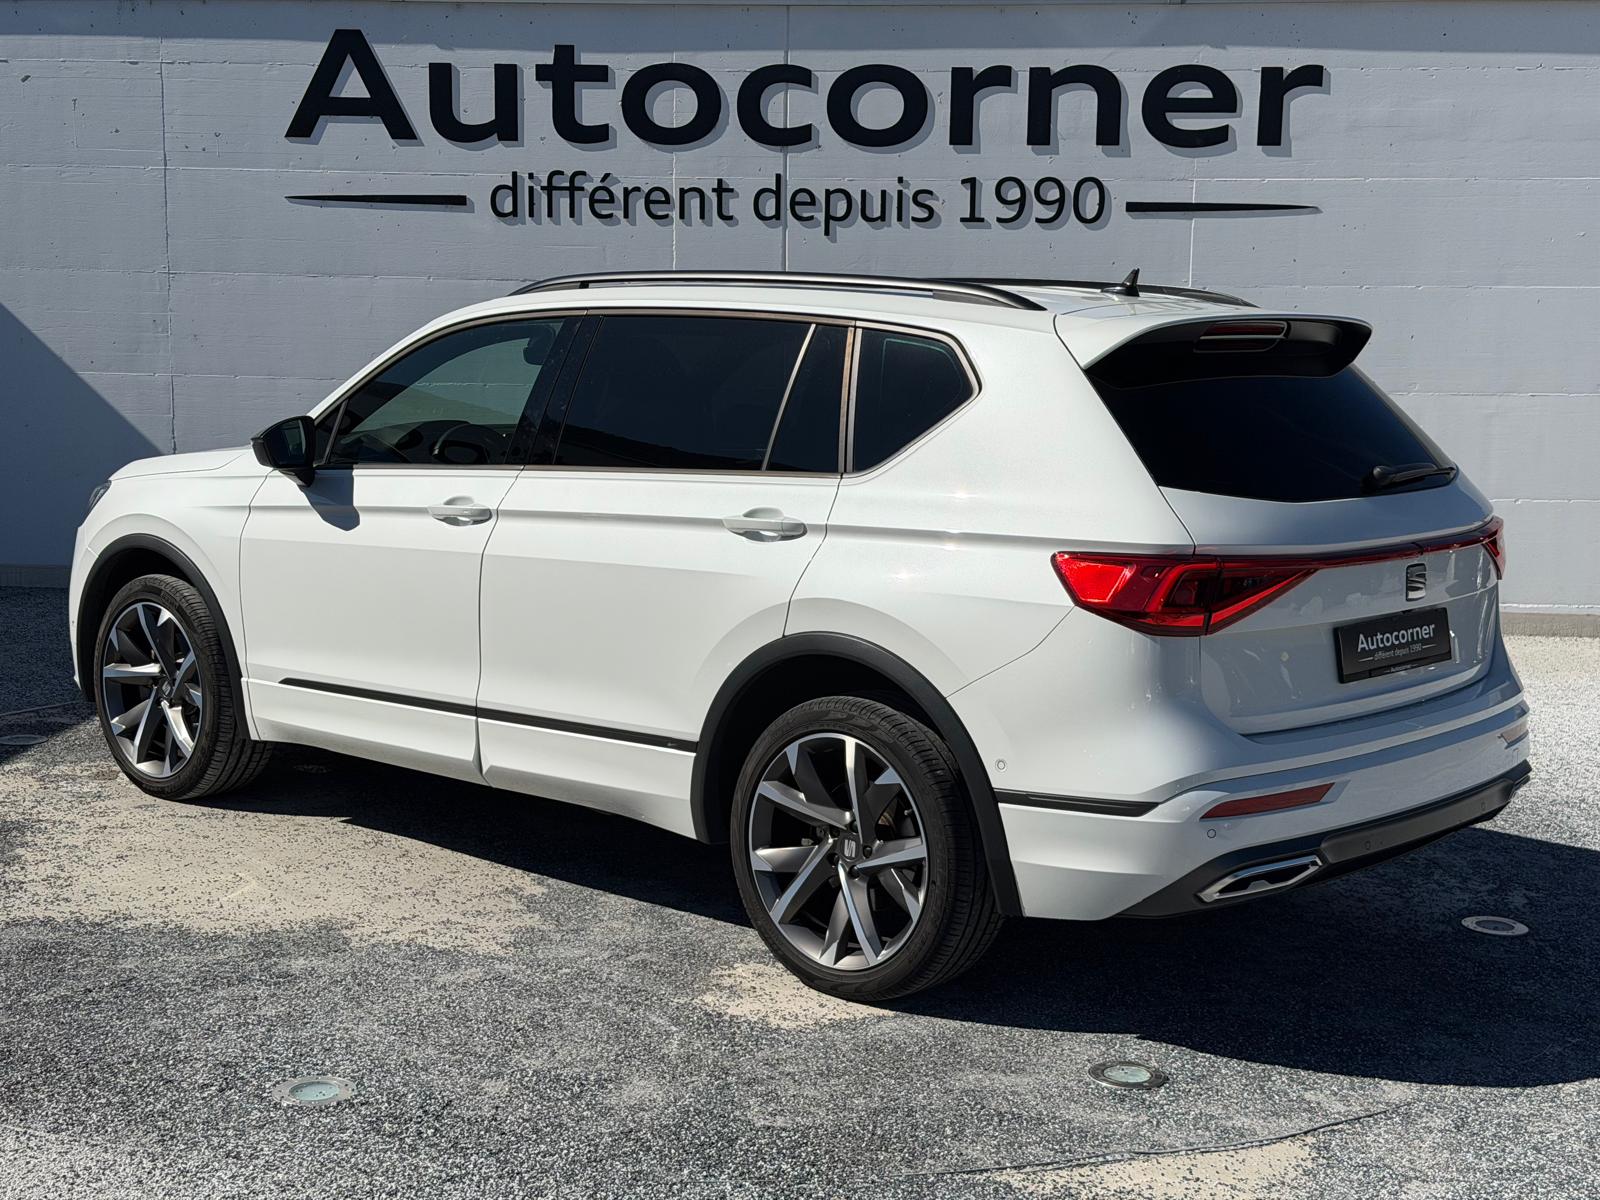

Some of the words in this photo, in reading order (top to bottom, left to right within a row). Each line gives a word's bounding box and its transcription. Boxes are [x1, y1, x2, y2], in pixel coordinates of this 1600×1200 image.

[284, 28, 1325, 147] Autocorner
[490, 170, 735, 221] différent
[752, 173, 935, 236] depuis
[959, 176, 1106, 224] 1990
[1357, 624, 1435, 652] Autocorner
